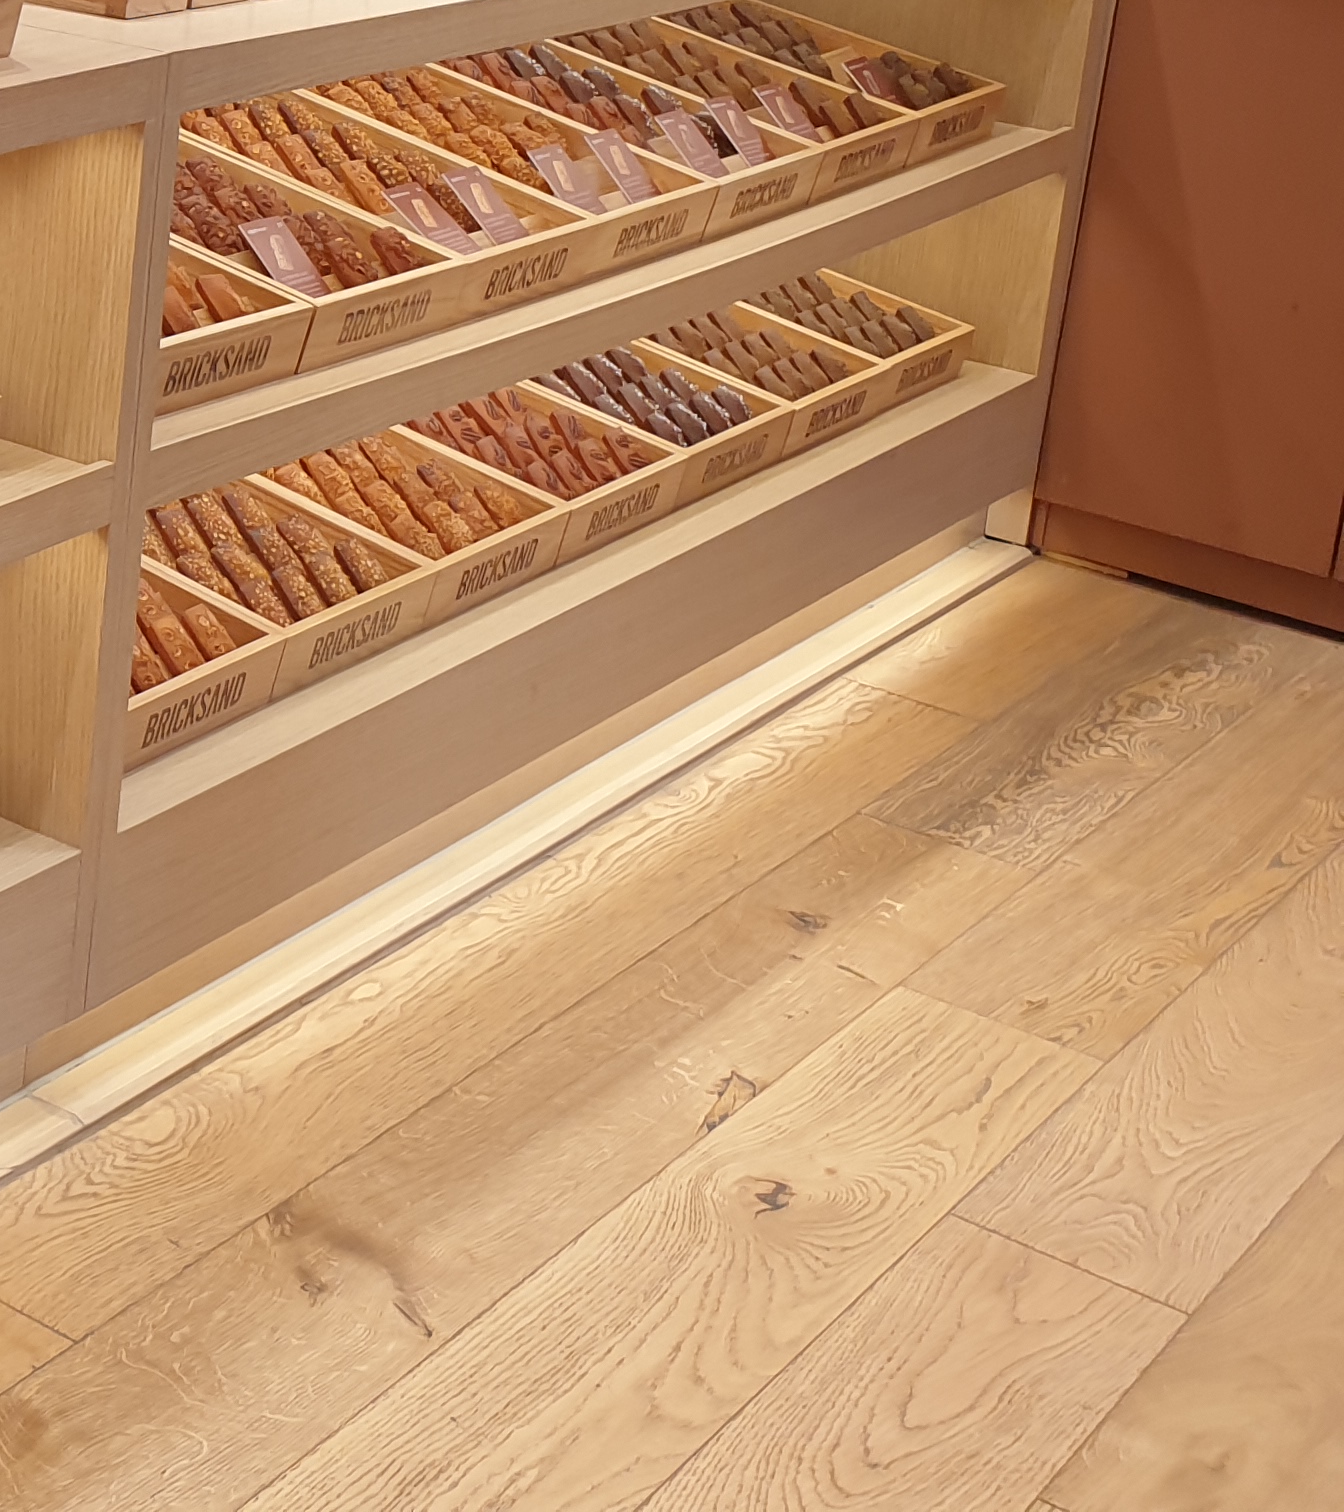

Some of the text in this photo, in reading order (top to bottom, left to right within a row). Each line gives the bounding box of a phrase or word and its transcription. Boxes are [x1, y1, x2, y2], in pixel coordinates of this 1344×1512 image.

[729, 173, 799, 219] BRICKSAND
[614, 209, 690, 258] BRICKSAND
[484, 248, 568, 299] BRICKSAND
[337, 289, 432, 345] BRICKSAND
[162, 335, 272, 396] BRICKSAND
[585, 484, 660, 541] BRICKSAND
[456, 538, 540, 600] BRICKSAND
[308, 602, 402, 669] BRICKSAND
[142, 673, 245, 749] BRICKSAND
